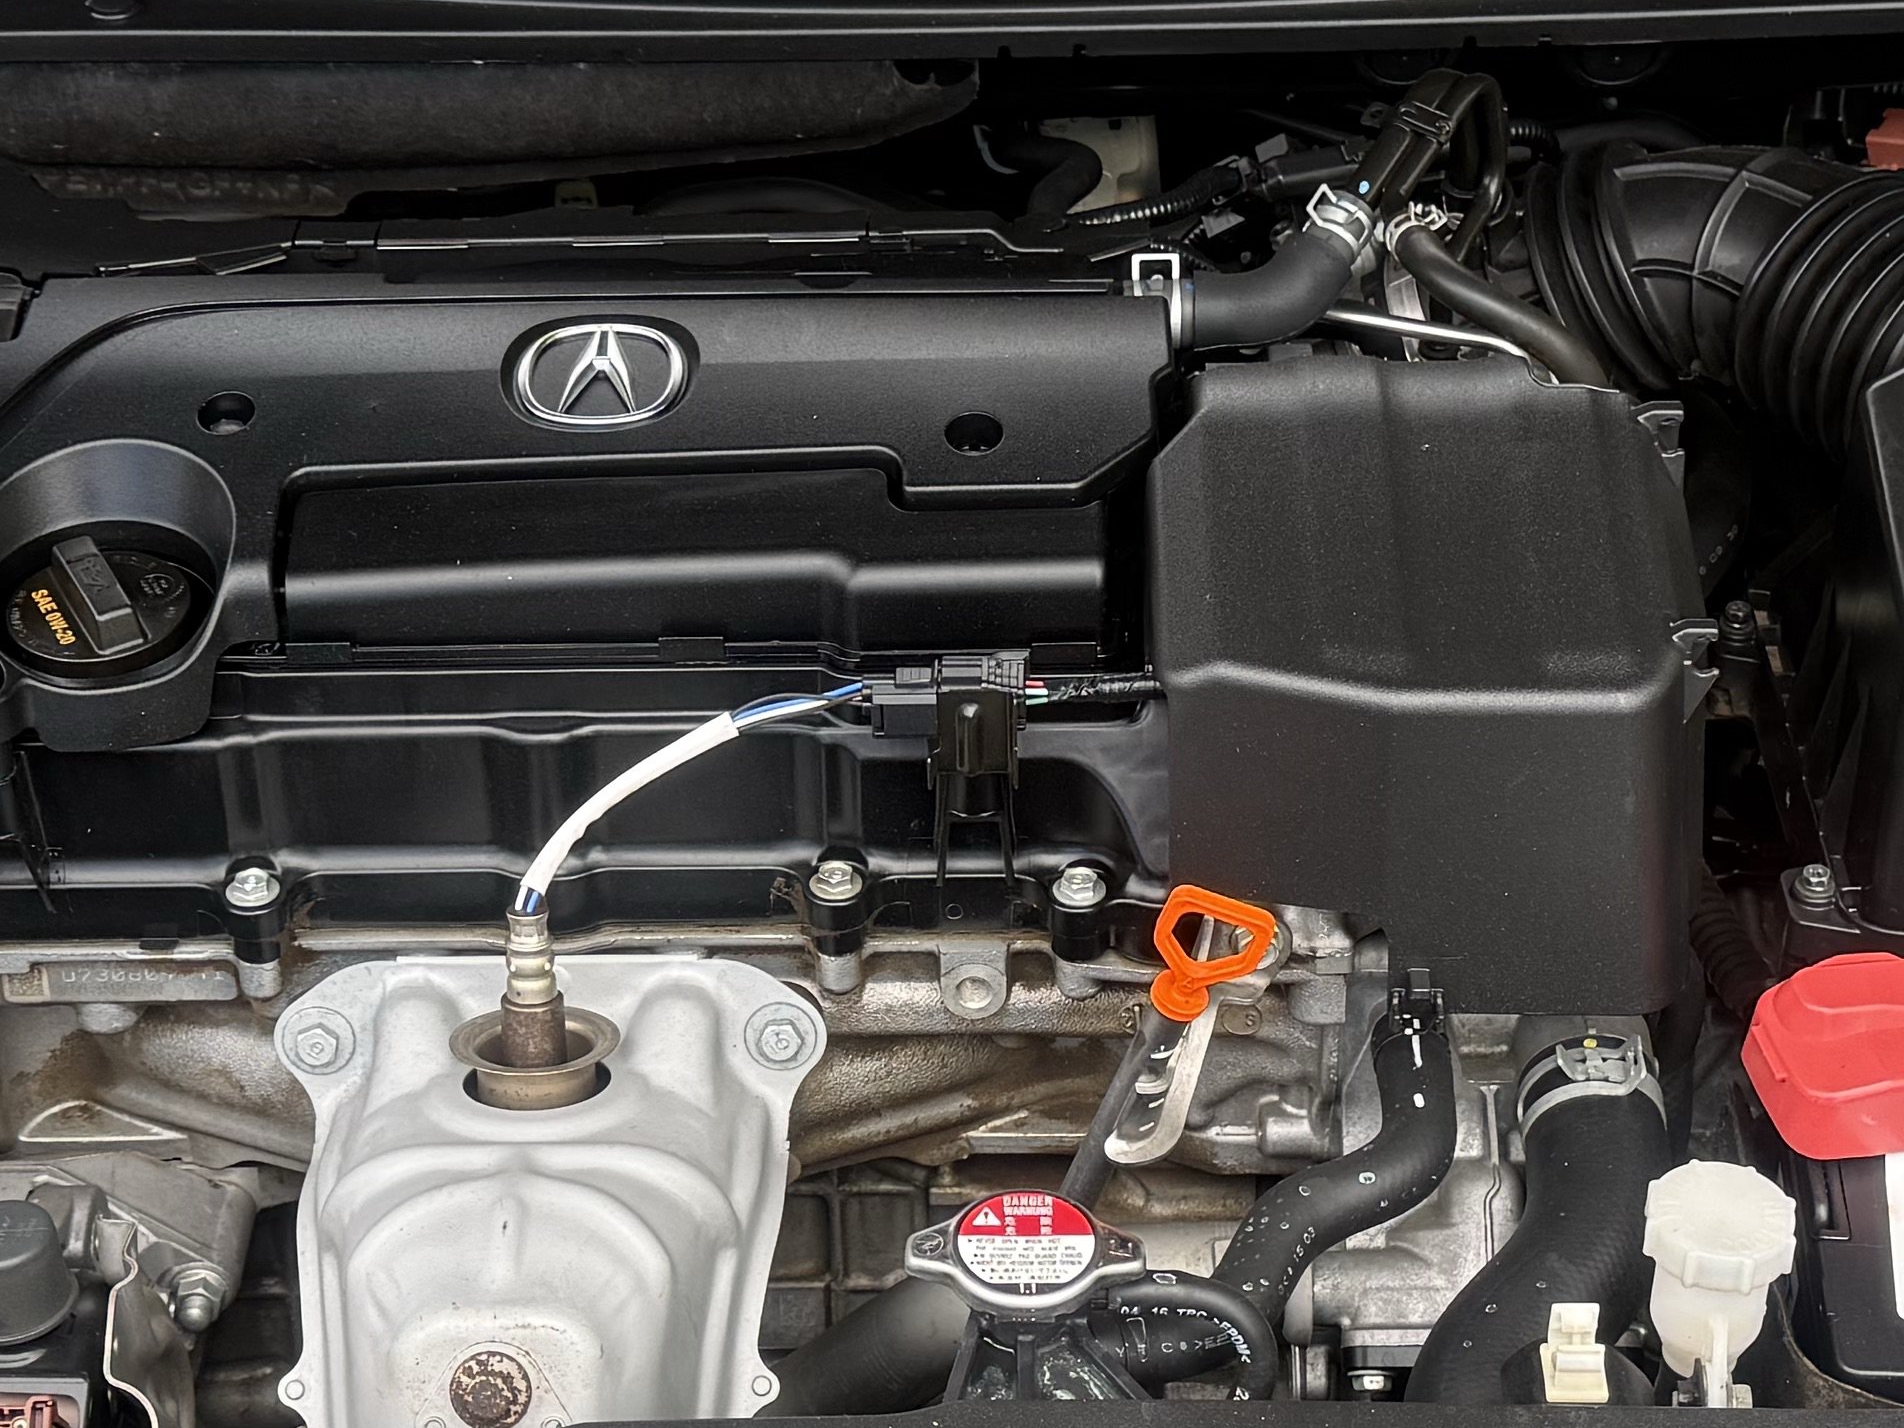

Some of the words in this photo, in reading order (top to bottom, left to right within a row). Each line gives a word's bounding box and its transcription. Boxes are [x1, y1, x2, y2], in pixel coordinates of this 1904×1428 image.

[31, 589, 56, 614] SAE
[45, 609, 77, 645] 0W-20
[1003, 1195, 1053, 1206] DANGER
